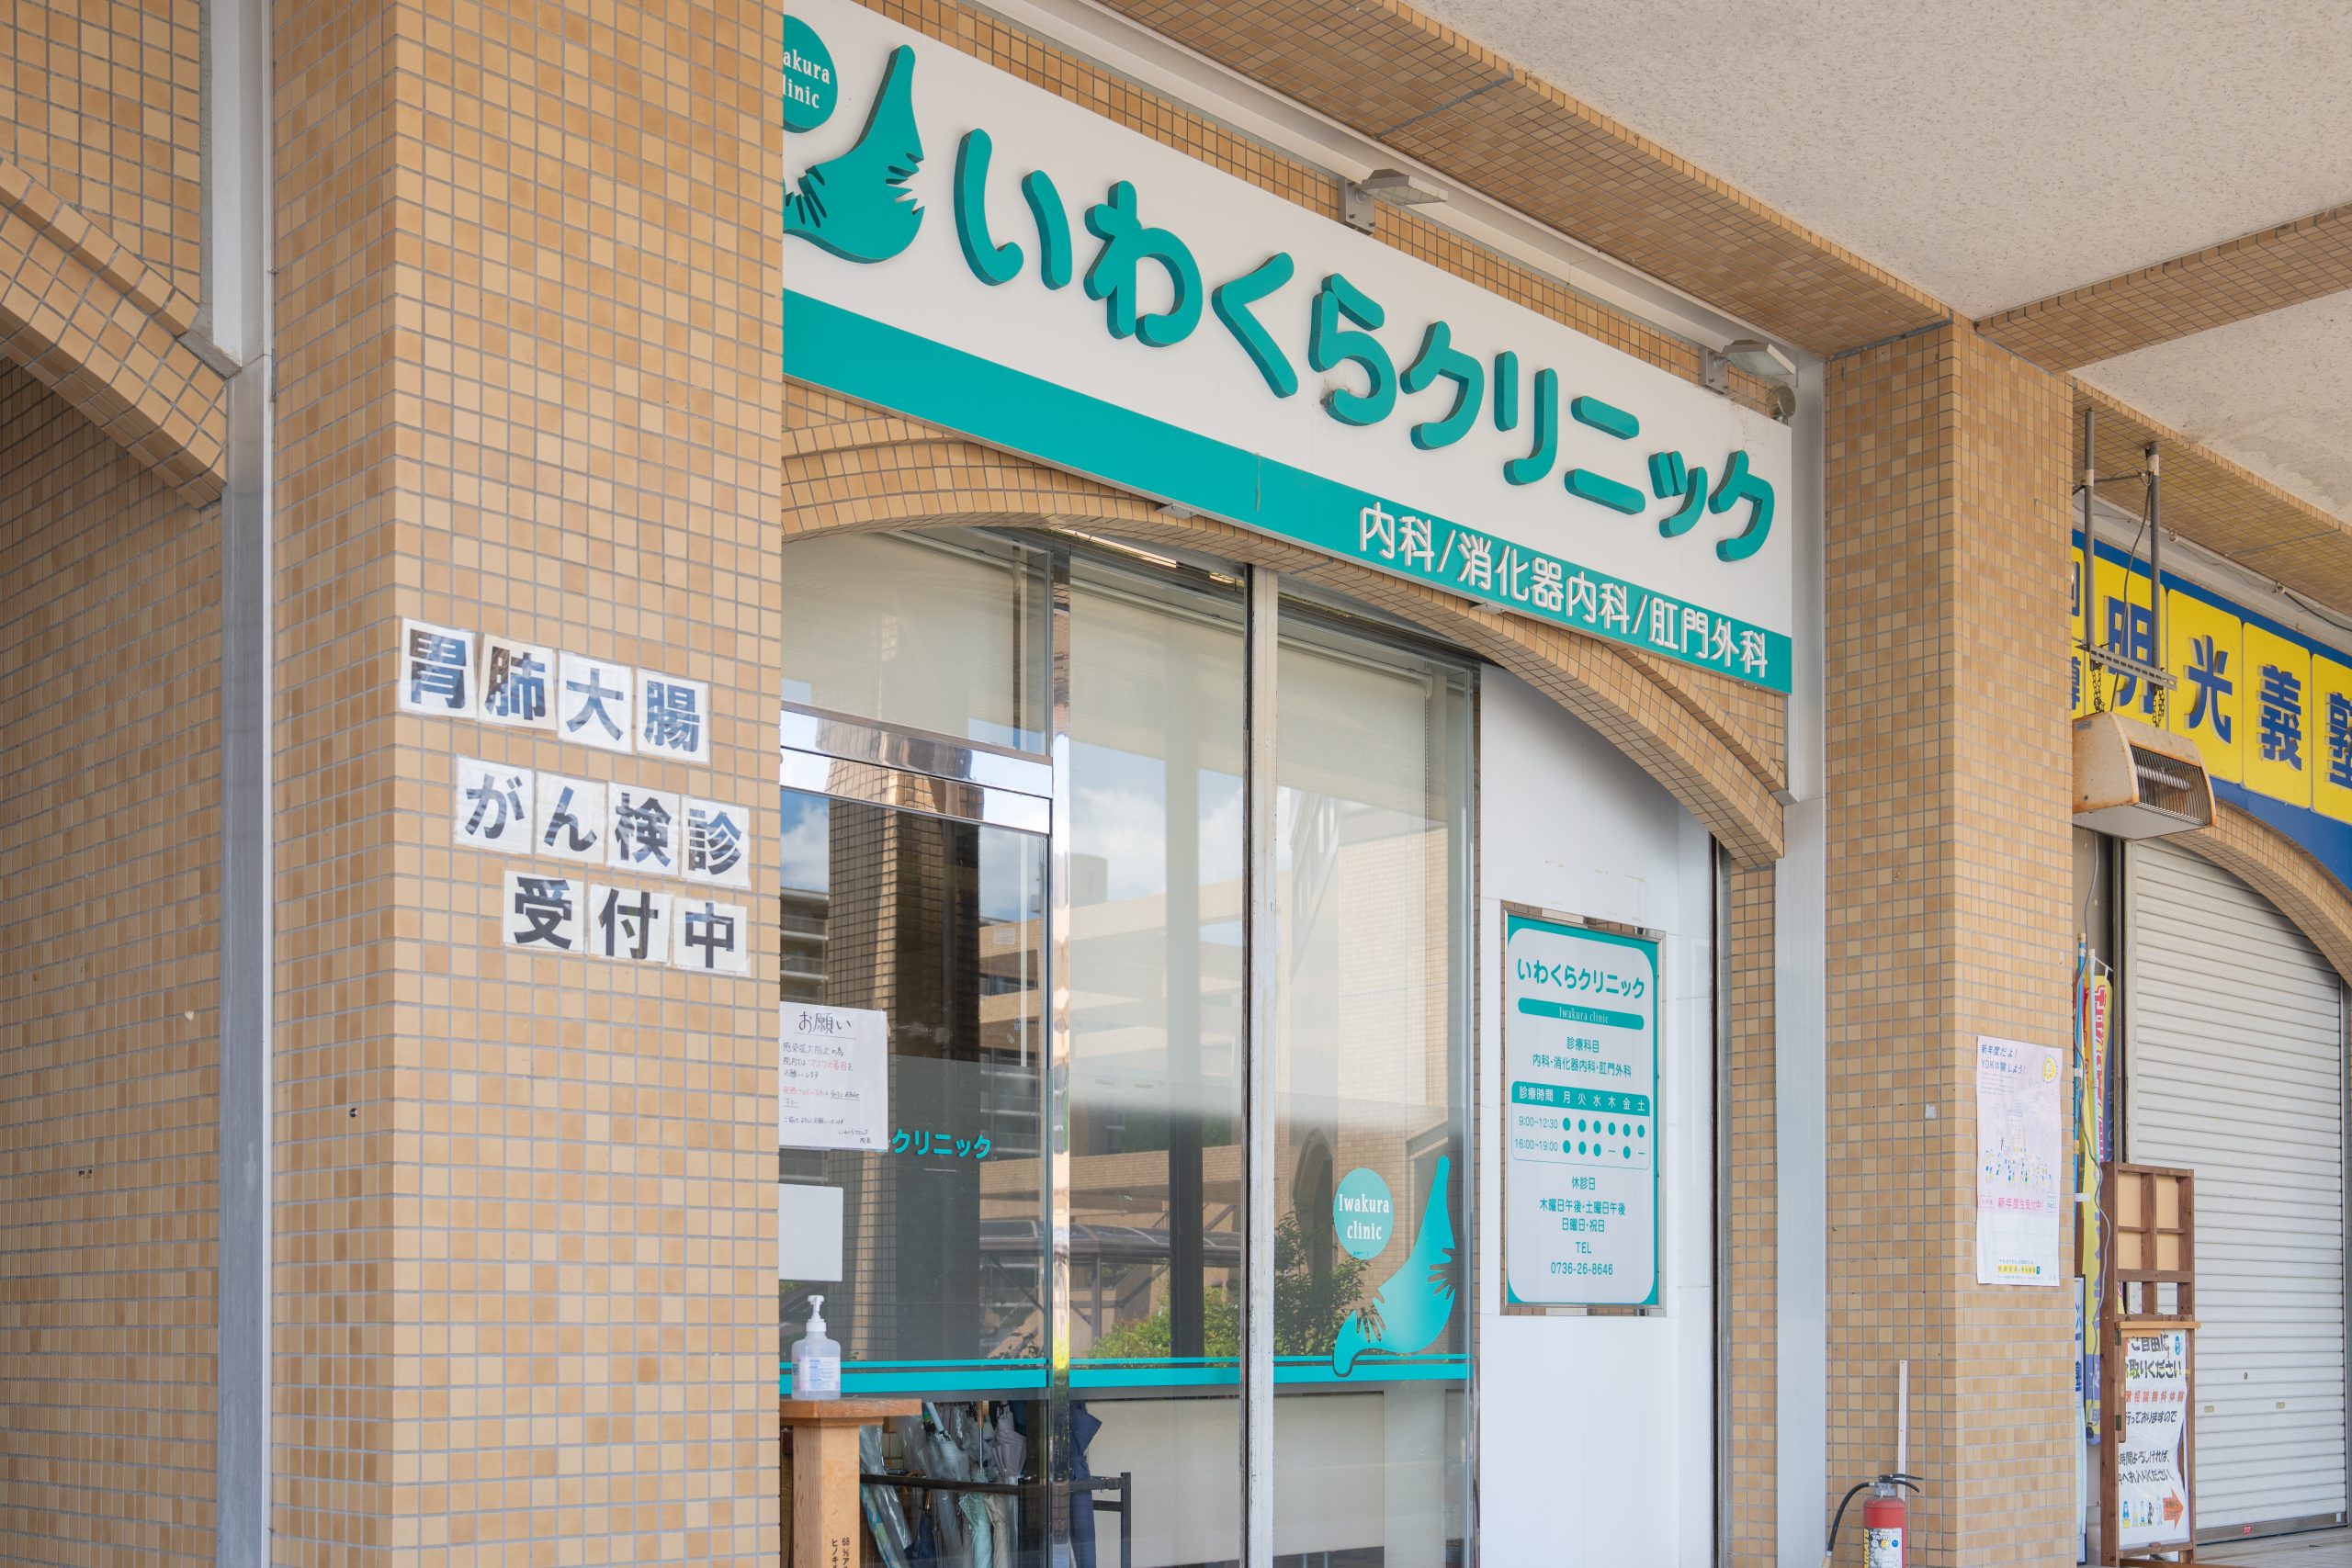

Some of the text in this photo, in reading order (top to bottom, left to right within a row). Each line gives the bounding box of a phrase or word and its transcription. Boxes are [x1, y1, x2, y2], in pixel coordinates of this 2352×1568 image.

[954, 128, 1775, 562] いわくらクリニック
[410, 628, 700, 753] 胃肺大腸
[465, 773, 742, 875] がん検診
[514, 875, 735, 969] 受付中
[1517, 957, 1645, 999] いわくらクリニック
[798, 1010, 852, 1034] お願い
[1559, 1007, 1609, 1024] Iwakura clinic
[1566, 1036, 1600, 1054] 診療科目
[1519, 1086, 1645, 1111] 診療時間 月 火 水 木 金 土
[892, 1128, 991, 1159] クリニック
[1572, 1176, 1596, 1190] 休診日
[1339, 1193, 1390, 1213] Iwakura
[1540, 1198, 1626, 1216] 木曜日午後・土曜日午後
[1347, 1220, 1382, 1240] clinic
[1562, 1217, 1605, 1233] 日曜日・祝日
[1576, 1241, 1592, 1254] TEL
[1550, 1261, 1613, 1276] 0736-26-8646
